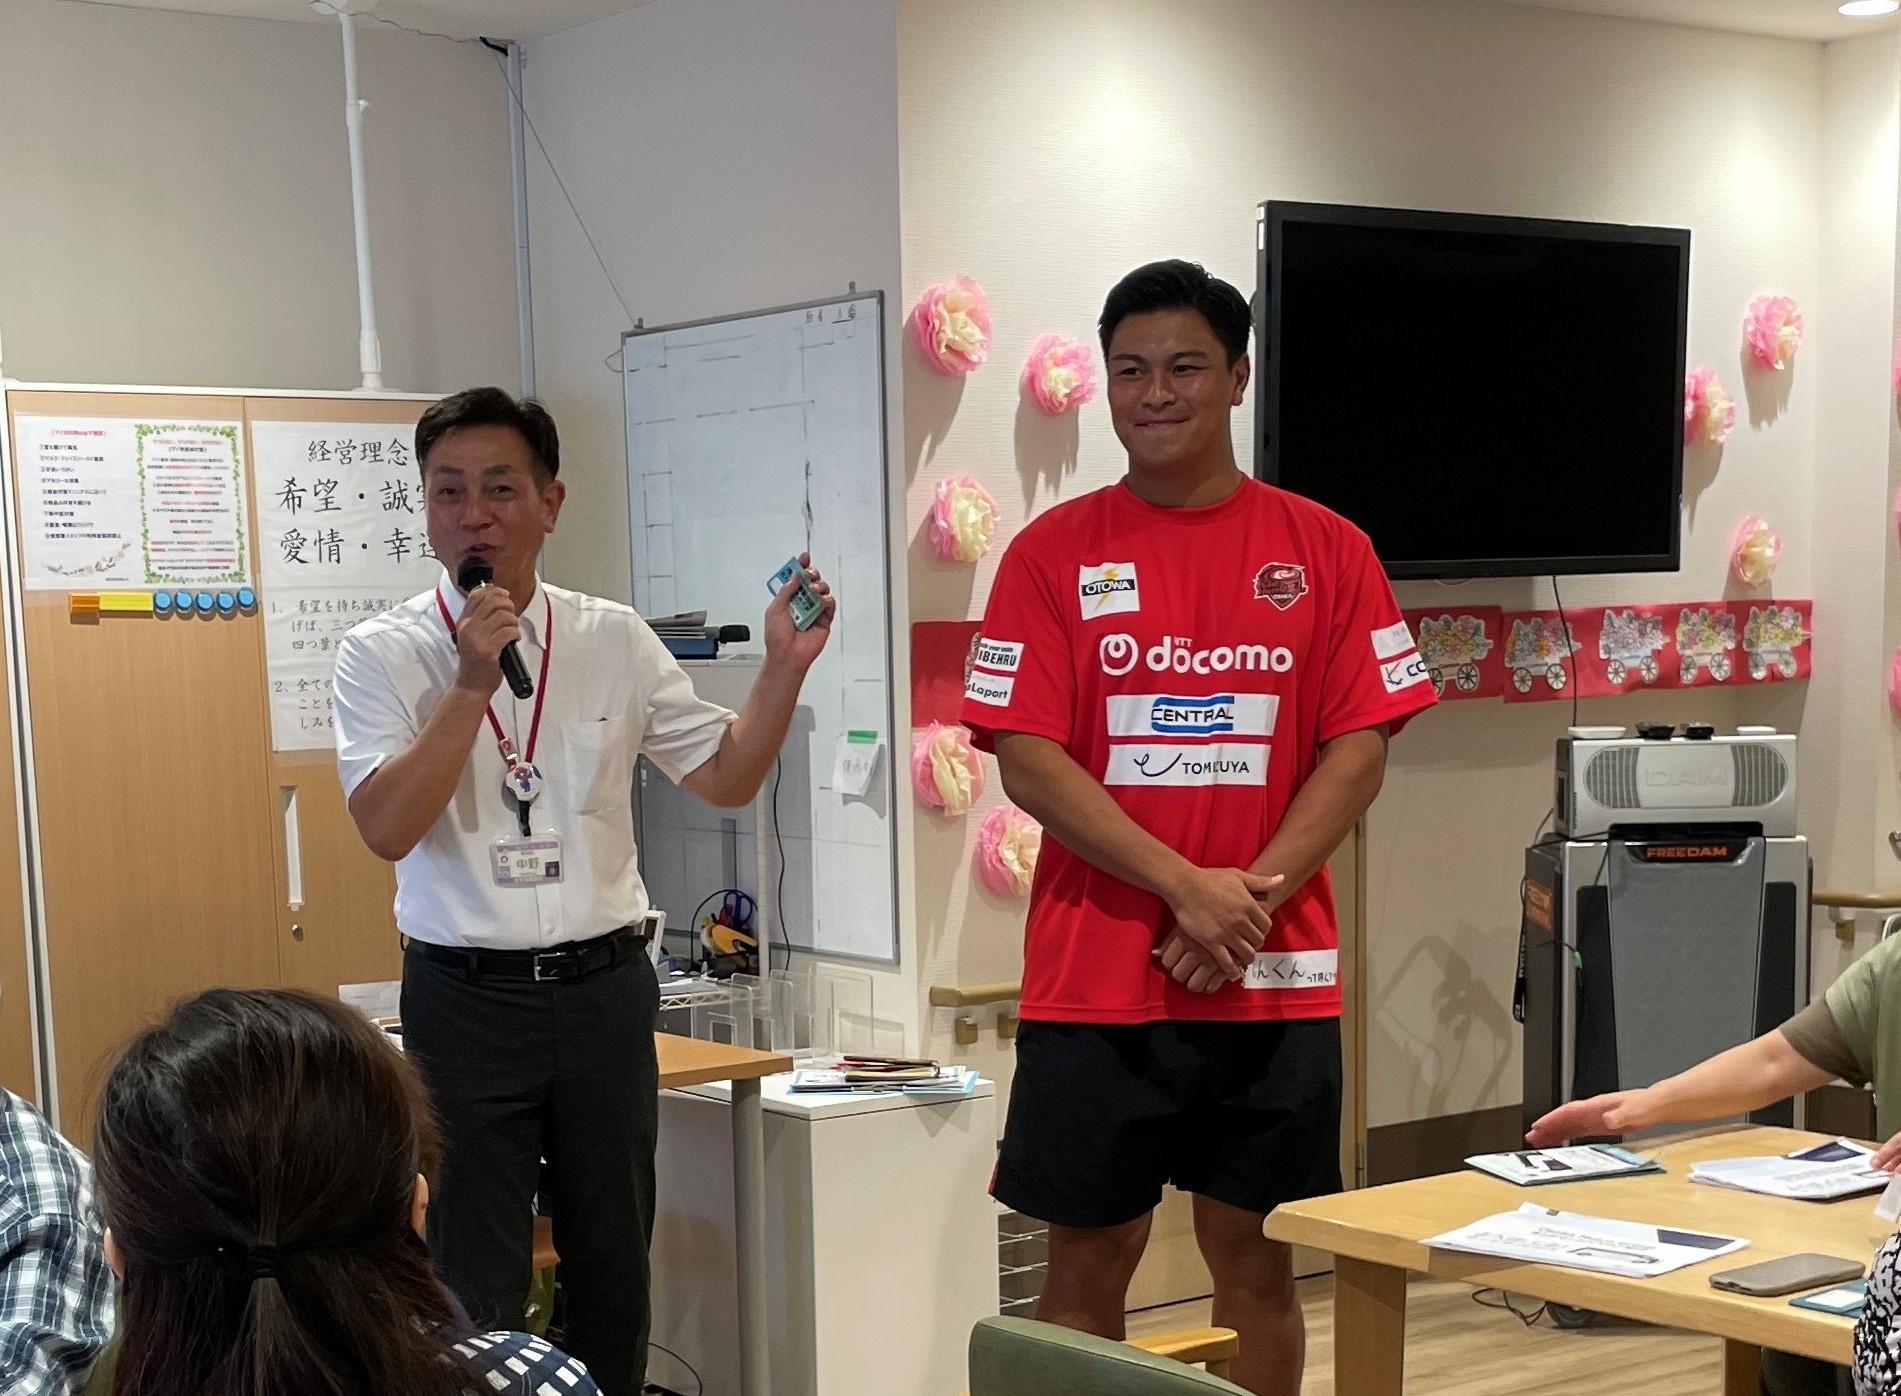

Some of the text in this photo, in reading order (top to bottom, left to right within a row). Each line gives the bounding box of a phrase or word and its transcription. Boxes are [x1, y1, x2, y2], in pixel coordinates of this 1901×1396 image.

[307, 438, 410, 466] 経営理念
[1085, 580, 1131, 594] OTOWA
[299, 599, 410, 615] 希望を持ち誠実に
[291, 617, 368, 633] げば、三つ
[1145, 635, 1294, 675] docomo
[1151, 706, 1234, 723] CENTRAL
